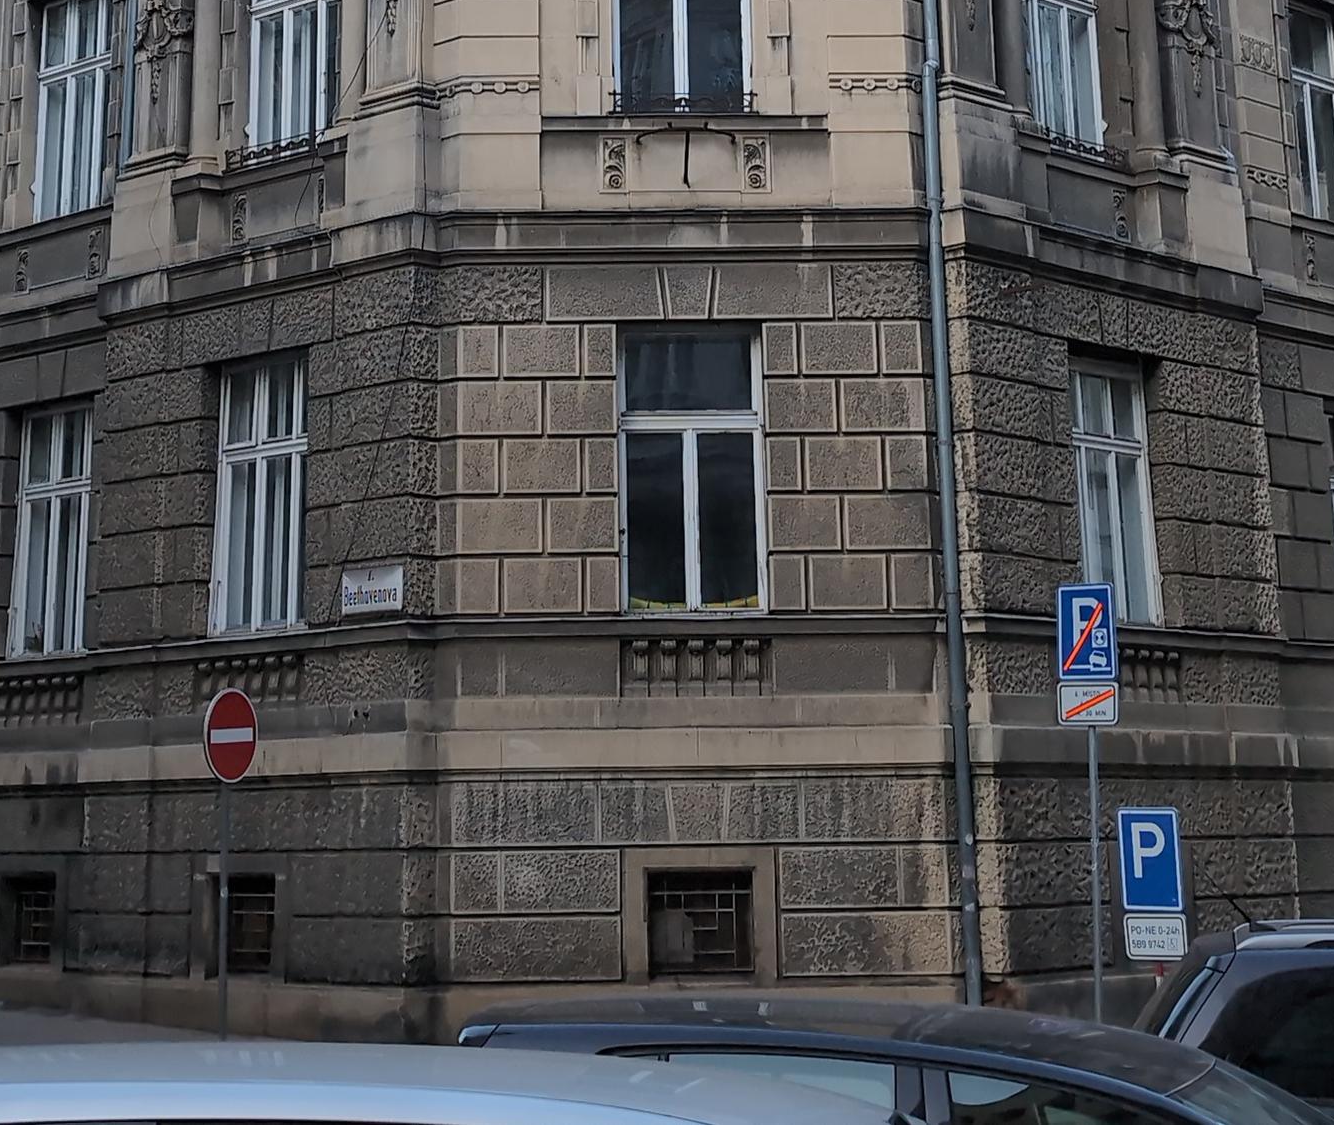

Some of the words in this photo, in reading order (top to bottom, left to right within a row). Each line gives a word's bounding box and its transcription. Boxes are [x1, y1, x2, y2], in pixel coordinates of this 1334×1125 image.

[343, 585, 398, 607] Beethovenova
[1072, 597, 1103, 647] P
[1130, 821, 1166, 879] P
[1130, 925, 1156, 935] PO-NE
[1158, 925, 1180, 935] 0-24h
